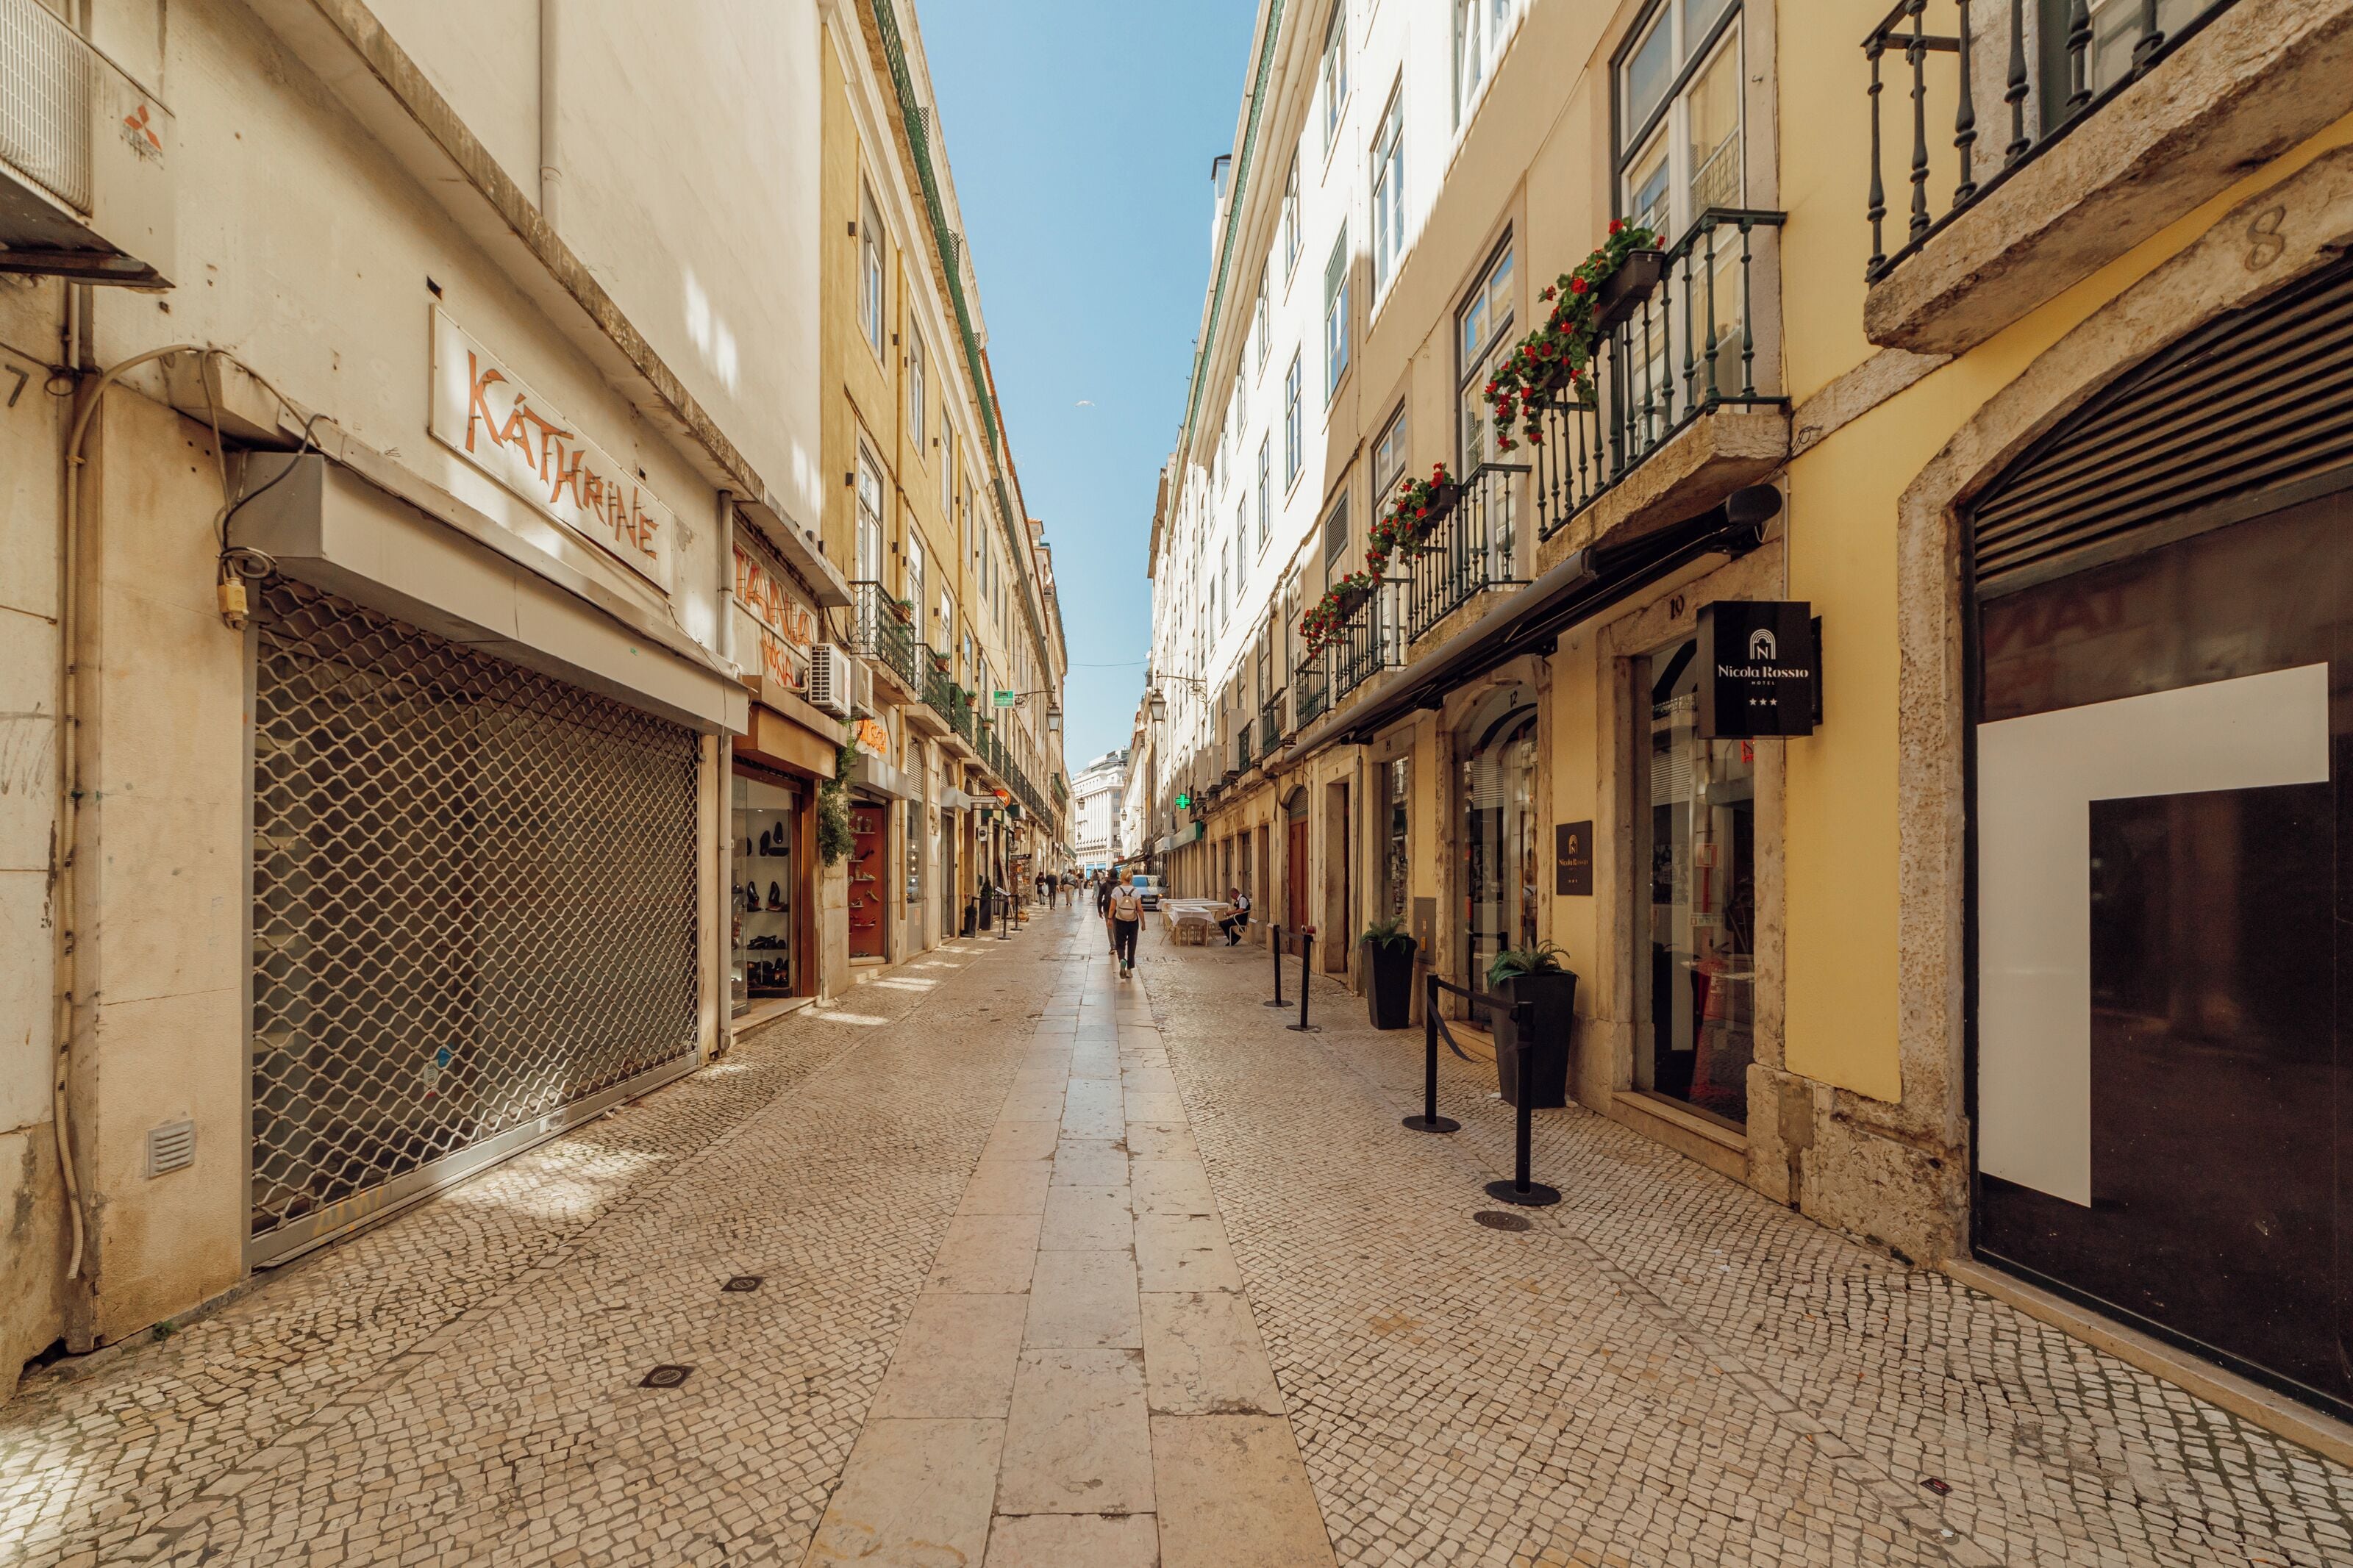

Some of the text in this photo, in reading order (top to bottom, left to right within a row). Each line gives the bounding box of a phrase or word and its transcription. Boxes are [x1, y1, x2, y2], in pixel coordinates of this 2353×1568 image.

[2244, 206, 2286, 271] 8
[1670, 595, 1685, 620] 10
[1718, 664, 1760, 678] Nicola
[1510, 690, 1518, 708] 12
